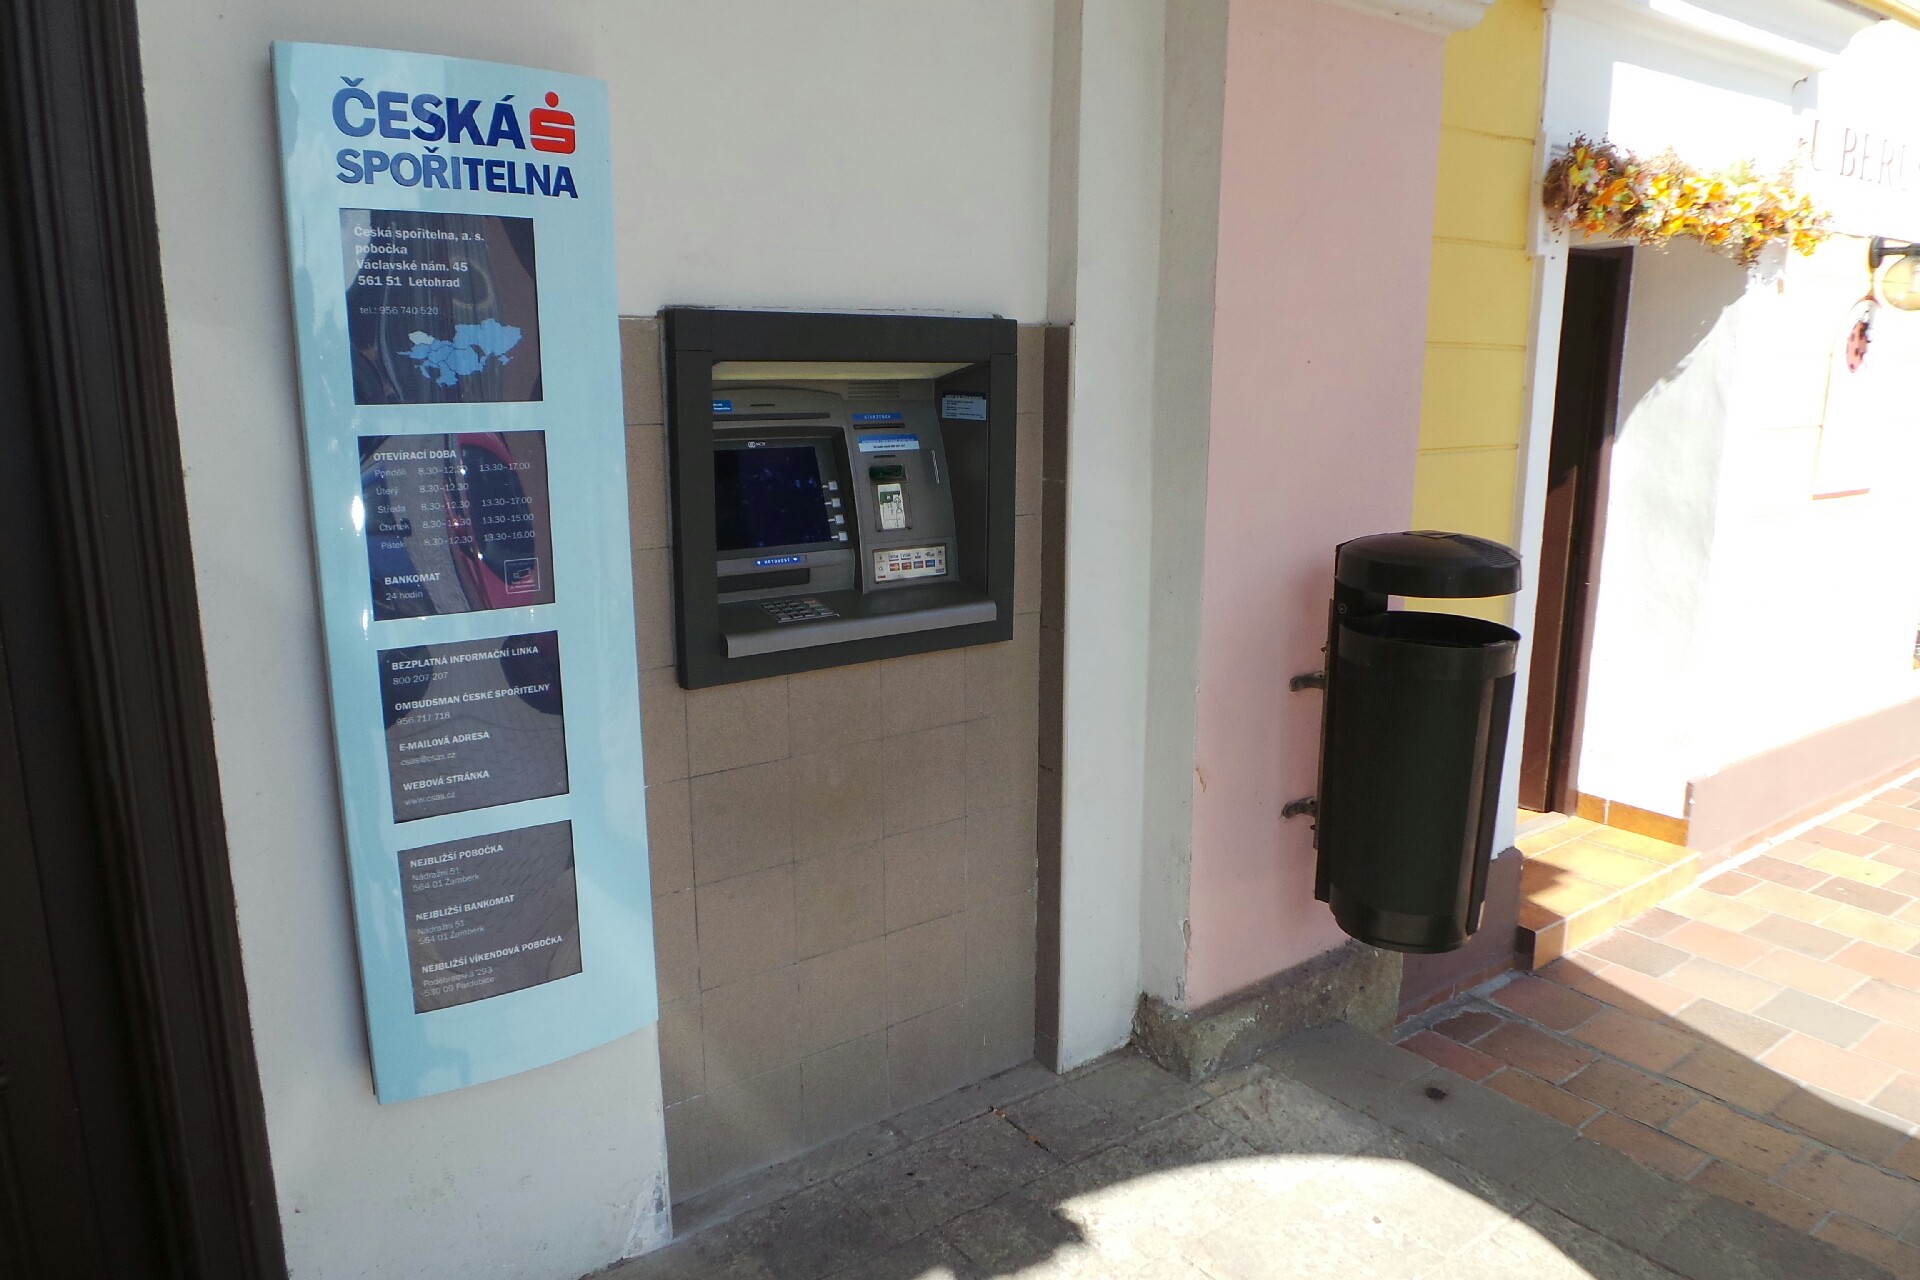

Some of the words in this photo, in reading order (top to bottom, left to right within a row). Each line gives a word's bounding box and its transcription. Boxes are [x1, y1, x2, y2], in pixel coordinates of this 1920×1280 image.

[331, 76, 526, 150] ČESKÁ
[336, 146, 579, 199] SPOŘITELNA
[354, 225, 391, 238] Česká
[395, 228, 458, 241] spořitelna,
[462, 232, 472, 241] a.
[475, 232, 485, 241] s.
[355, 242, 408, 255] pobočka
[357, 258, 417, 271] Václavské
[421, 261, 449, 271] nám.
[453, 261, 468, 272] 45
[358, 275, 383, 286] 561
[386, 276, 402, 286] 51
[409, 276, 460, 288] Letohrad
[379, 306, 398, 315] 956
[400, 306, 418, 315] 740
[420, 307, 438, 315] 520
[373, 449, 427, 461] OTEVÍRACÍ
[430, 449, 457, 459] DOBA
[479, 462, 530, 472] 13.30-17.00
[419, 483, 469, 493] 8.30-12.30
[378, 505, 406, 514] Středa
[421, 500, 470, 510] 8.30-12.30
[482, 497, 532, 507] 13.30-17.00
[384, 573, 440, 585] BANKOMAT
[386, 592, 397, 601] 24
[400, 591, 423, 599] hodin
[392, 657, 448, 671] BEZPLATNÁ
[450, 648, 509, 665] INFORMAČNÍ
[512, 646, 539, 656] LINKA
[393, 677, 411, 685] 800
[413, 674, 429, 683] 207
[432, 672, 448, 681] 207
[395, 696, 460, 711] OMBUDSMAN
[463, 691, 493, 702] ČESKÉ
[495, 683, 550, 698] SPOŘITELNY
[396, 718, 414, 726] 956
[417, 715, 432, 723] 717
[435, 712, 450, 720] 718
[399, 735, 450, 751] E-MAILOVÁ
[452, 731, 490, 743] ADRESA
[401, 752, 456, 766] csas@csas.cz
[403, 777, 444, 791] WEBOVÁ
[446, 770, 490, 784] STRÁNKA
[405, 792, 455, 805] www.csas.cz
[410, 852, 457, 868] NEJBLIŽŠÍ
[459, 844, 503, 859] POBOČKA
[450, 867, 459, 875] 51
[413, 883, 431, 891] 564
[432, 880, 444, 888] 01
[416, 904, 462, 921] NEJBLIŽŠÍ
[464, 894, 515, 912] BANKOMAT
[455, 920, 464, 928] 51
[418, 936, 435, 944] 564
[438, 933, 448, 941] 01
[422, 956, 468, 973] NEJBLIŽŠÍ
[469, 944, 520, 964] VÍKENDOVÁ
[522, 935, 562, 951] POBOČKA
[476, 966, 493, 977] 293
[424, 988, 441, 997] 530
[443, 985, 454, 994] 09
